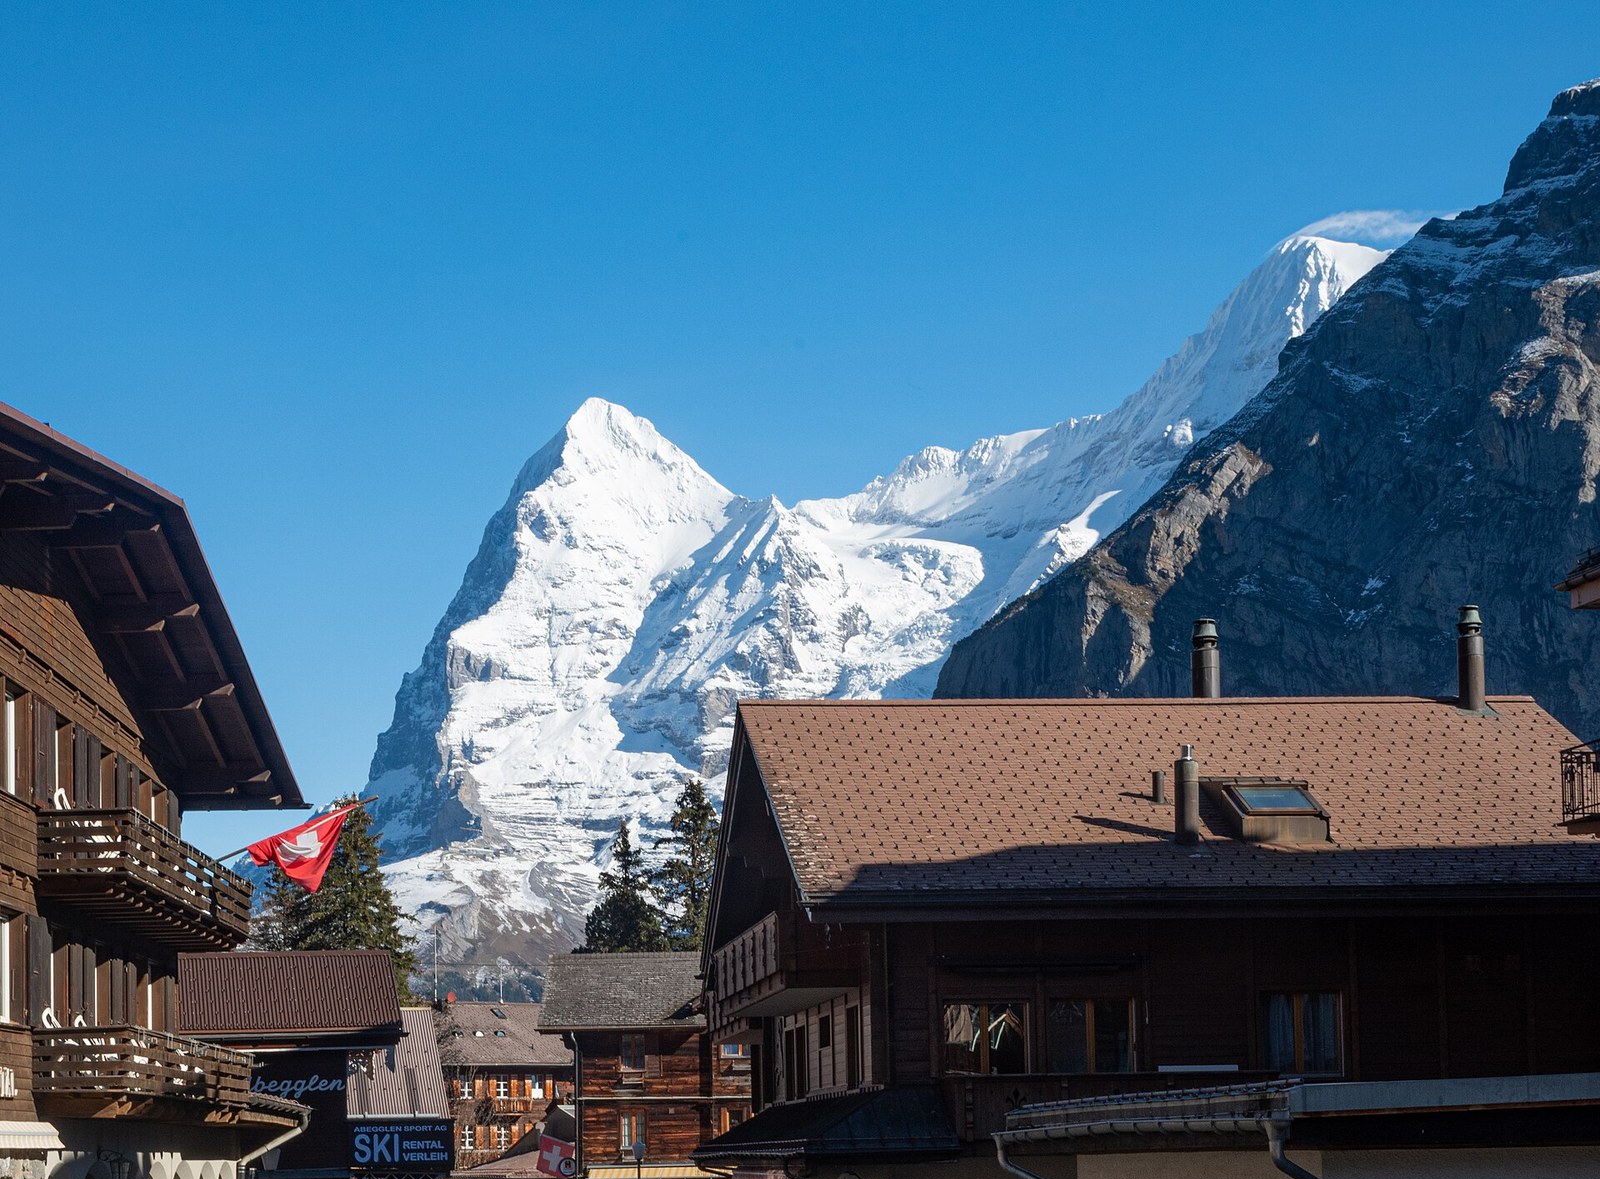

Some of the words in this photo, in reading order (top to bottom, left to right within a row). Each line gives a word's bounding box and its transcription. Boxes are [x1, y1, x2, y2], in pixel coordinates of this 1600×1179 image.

[249, 1074, 345, 1099] begglen
[354, 1125, 402, 1133] ABEGGLEN
[354, 1133, 400, 1163] SKI
[402, 1140, 444, 1149] RENTAL
[402, 1152, 448, 1161] VERLEIH
